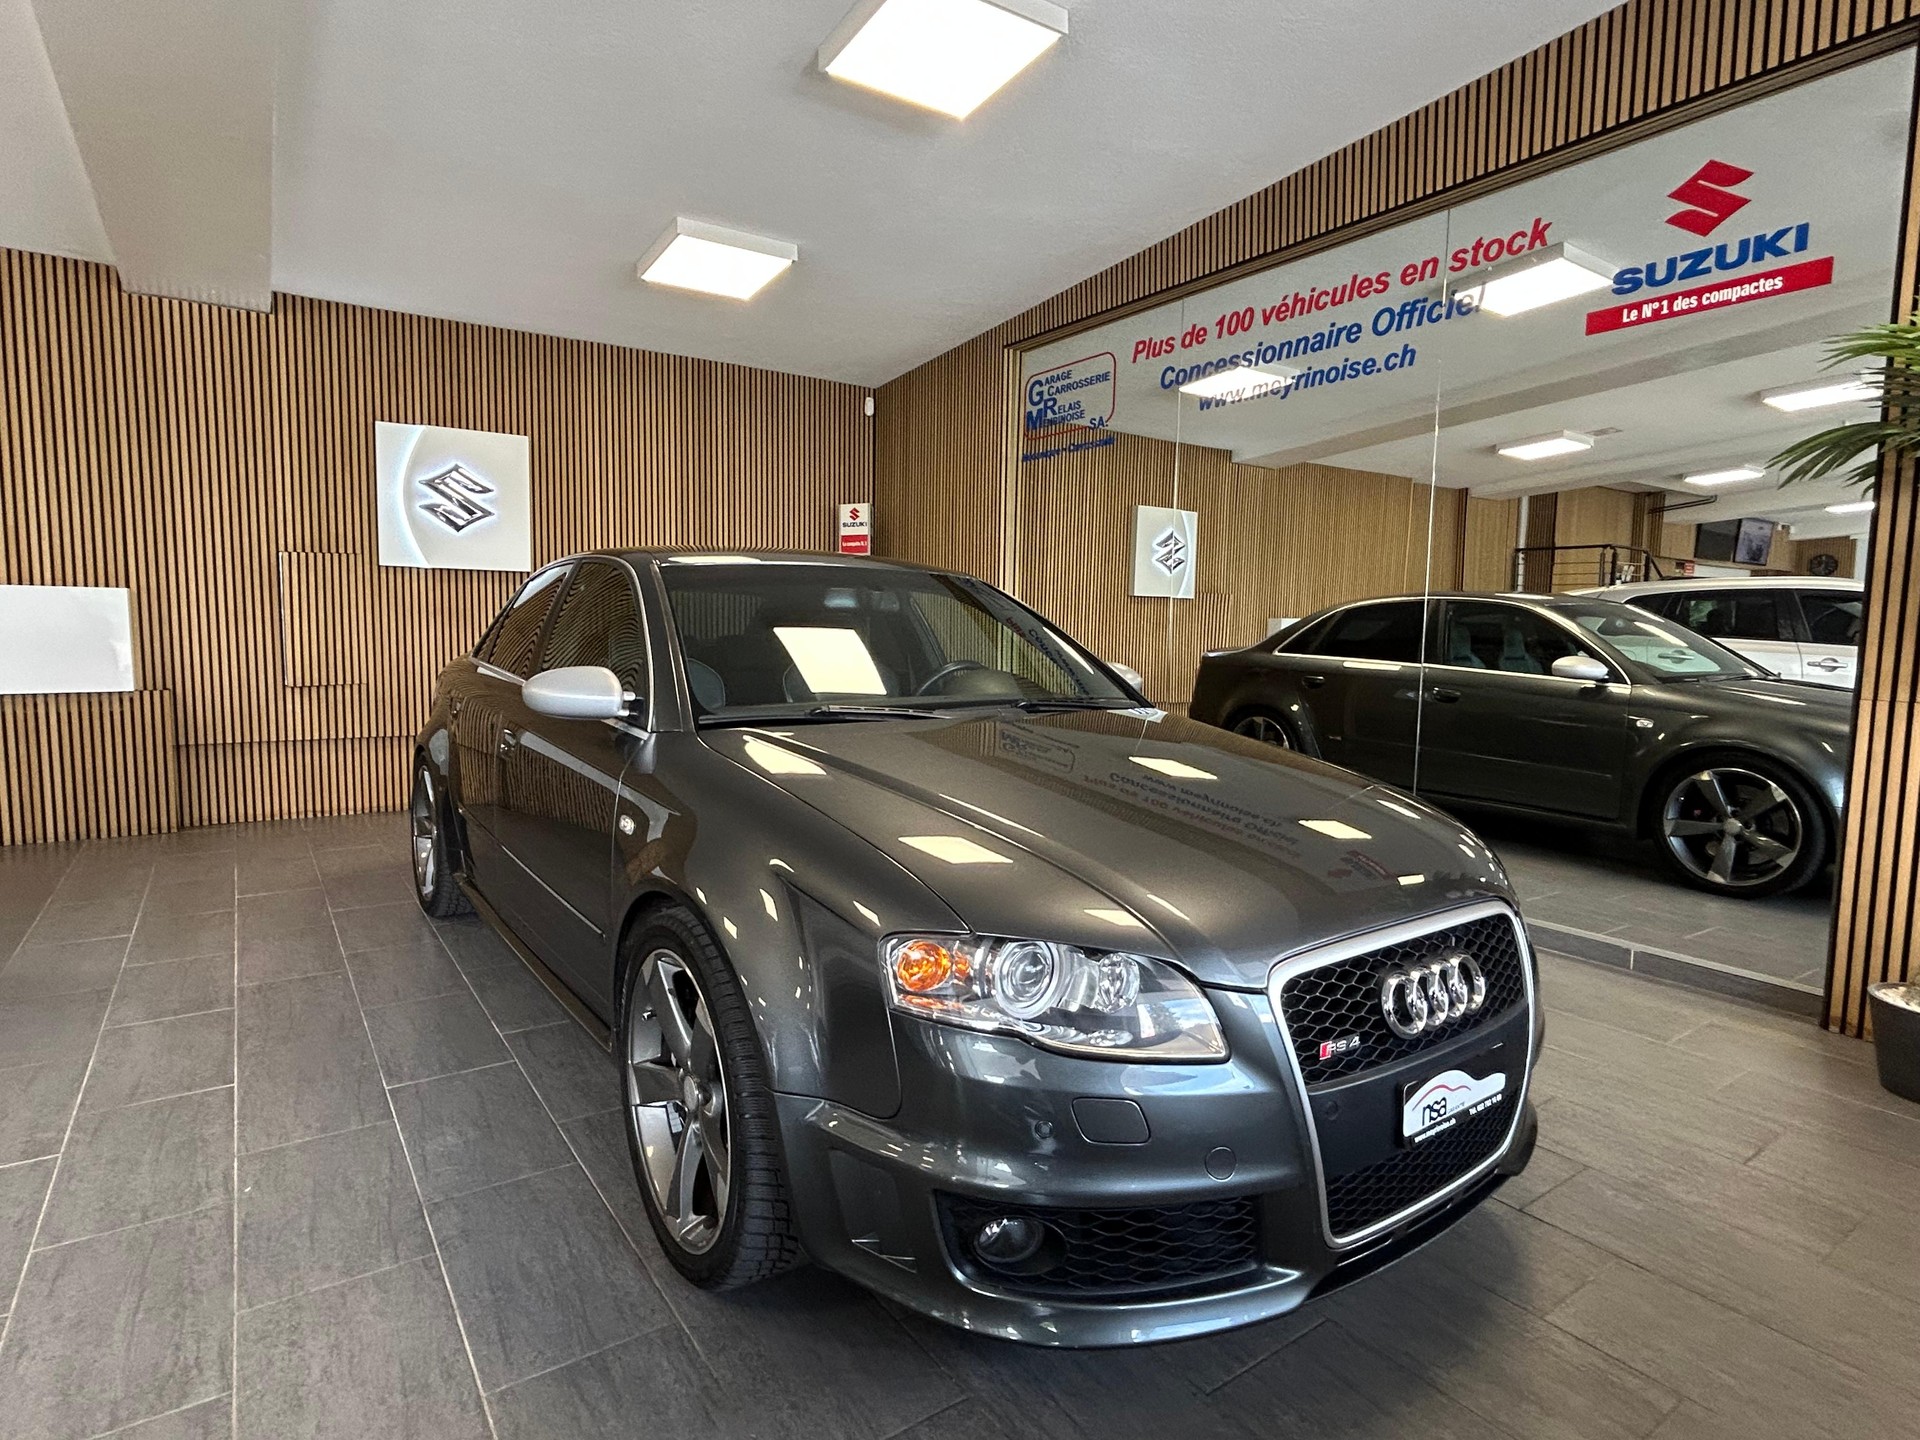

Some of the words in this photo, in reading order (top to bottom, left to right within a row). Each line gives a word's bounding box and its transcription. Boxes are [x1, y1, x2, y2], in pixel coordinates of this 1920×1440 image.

[1611, 222, 1810, 295] SUZUKI
[1131, 336, 1176, 364] Plus
[1181, 323, 1208, 349] de
[1215, 306, 1255, 339] 100
[1261, 271, 1391, 326] véhicules
[1400, 256, 1440, 286] en
[1448, 217, 1553, 272] stock
[1622, 308, 1638, 323] Le
[1673, 295, 1698, 312] des
[1702, 276, 1784, 305] compactes
[1160, 321, 1363, 389] Concessionnaire
[1371, 282, 1486, 337] Officiel
[1028, 370, 1073, 406] GARAGE
[1043, 397, 1082, 417] RELAIS
[1047, 371, 1111, 396] CARROSSERIE
